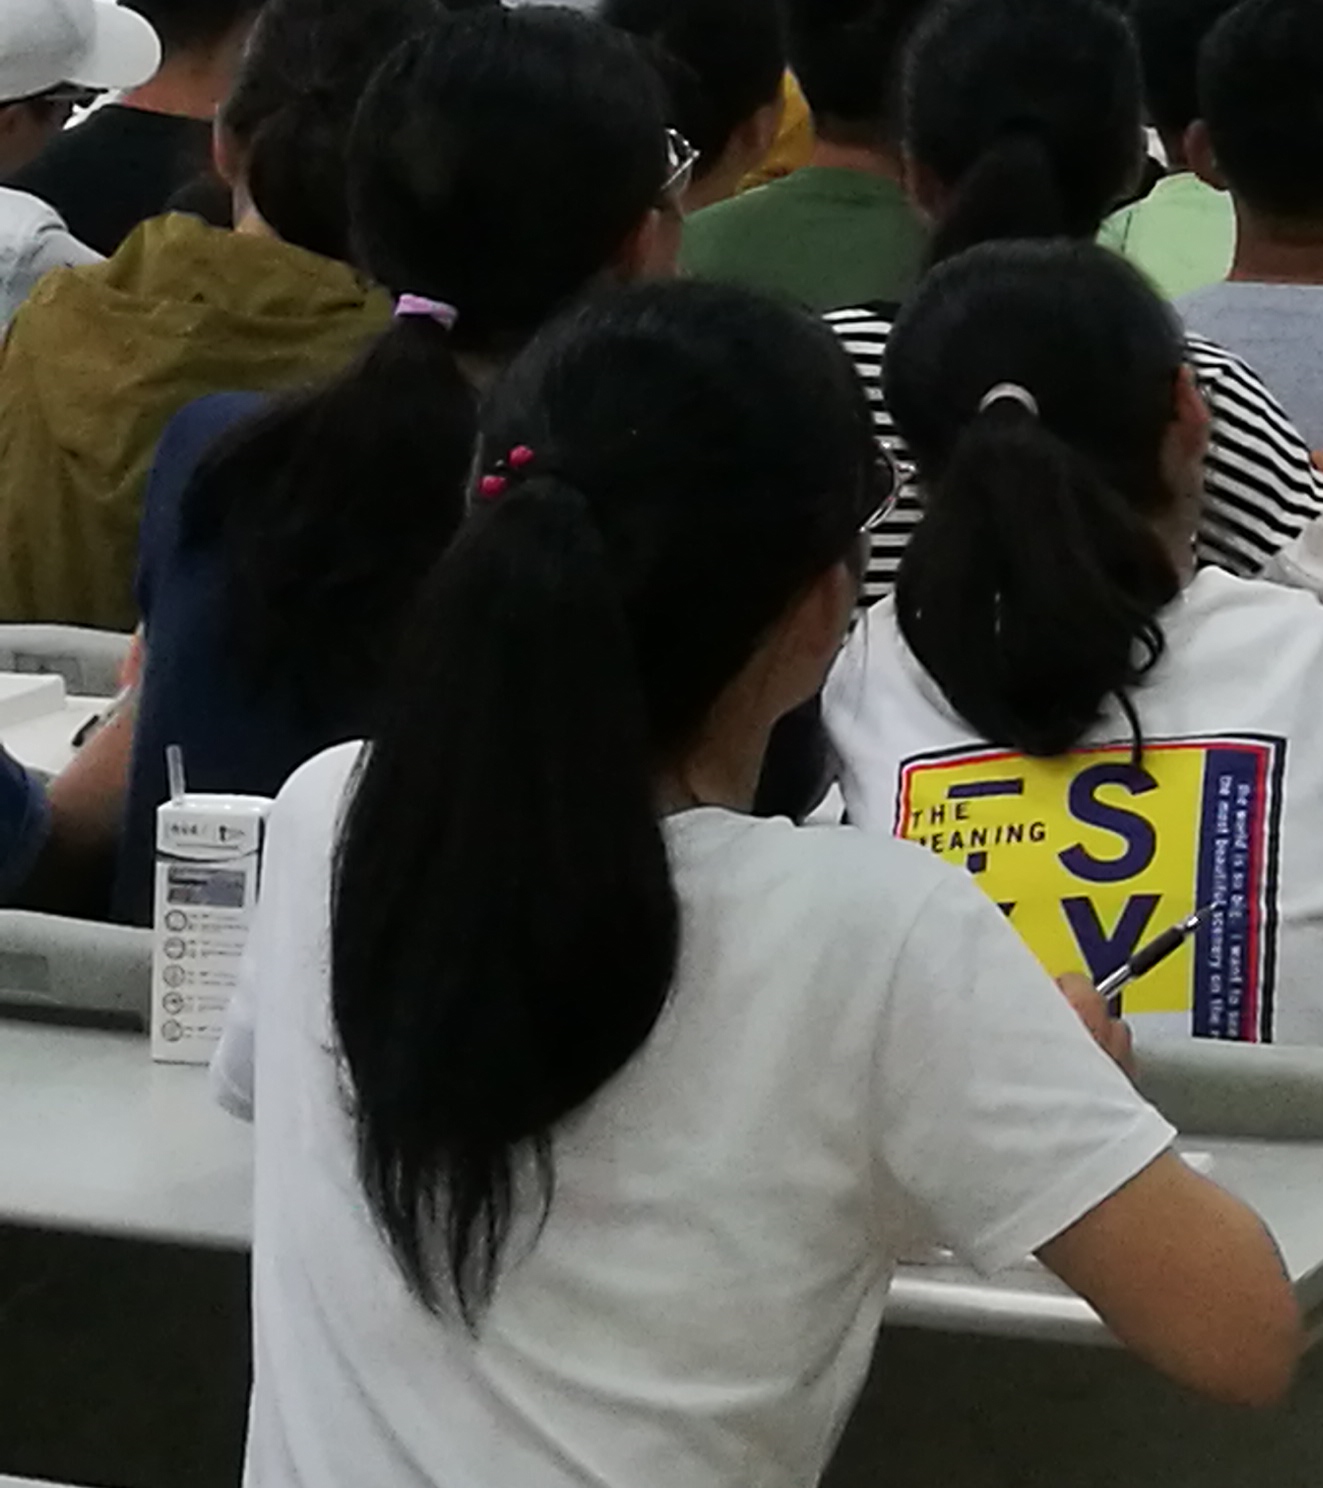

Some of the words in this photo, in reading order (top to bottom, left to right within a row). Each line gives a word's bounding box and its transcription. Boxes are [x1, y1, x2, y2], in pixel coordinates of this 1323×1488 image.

[910, 801, 971, 829] THE
[1216, 800, 1229, 834] most
[1233, 808, 1249, 849] world
[917, 821, 1047, 855] EANING
[1212, 838, 1229, 906] beautiful
[1208, 911, 1225, 969] scenery
[1228, 945, 1243, 983] want
